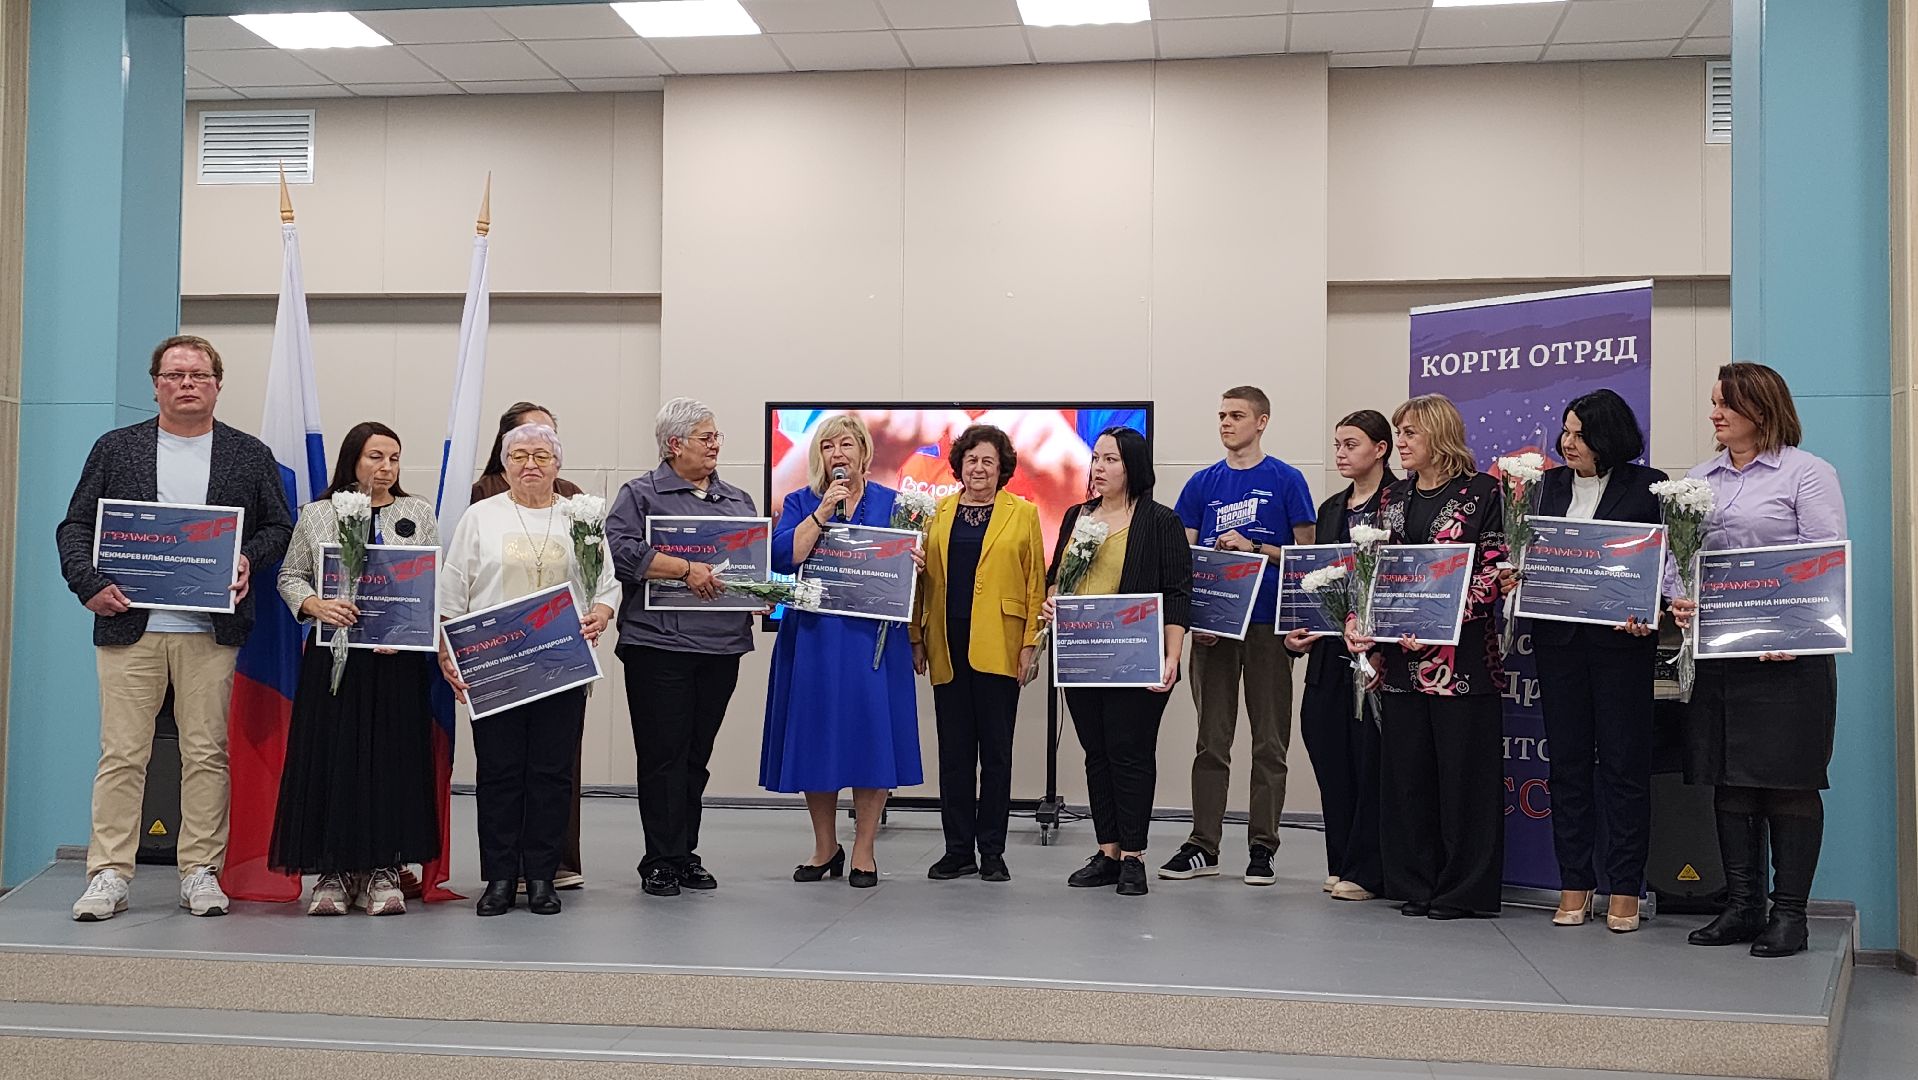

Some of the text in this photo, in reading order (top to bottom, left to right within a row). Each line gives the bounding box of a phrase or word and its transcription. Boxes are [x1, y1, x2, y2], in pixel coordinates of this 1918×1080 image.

[1421, 335, 1638, 378] КОРГИ ОТРЯД
[102, 531, 178, 544] ГРАМОТА
[100, 551, 217, 565] ЧЕКМАРЕВ ИЛЬЯ ВАСИЛЬЕВИЧ
[814, 547, 867, 560] РАМОТА
[1527, 545, 1601, 559] ГРАМОТА
[861, 570, 898, 579] ИВАНОВНА
[1524, 563, 1565, 573] ДАНИЛОВА
[1566, 567, 1593, 575] ГУЗАЛЬ
[1701, 578, 1781, 592] ГРАМОТА
[1700, 596, 1830, 610] ЧИЧИКИНА ИРИНА НИКОЛАЕВНА
[455, 630, 527, 657] ГРАМОТА
[461, 635, 573, 675] ЗАГОРУЙКО НИНА АЛЕКСАНДРОВНА
